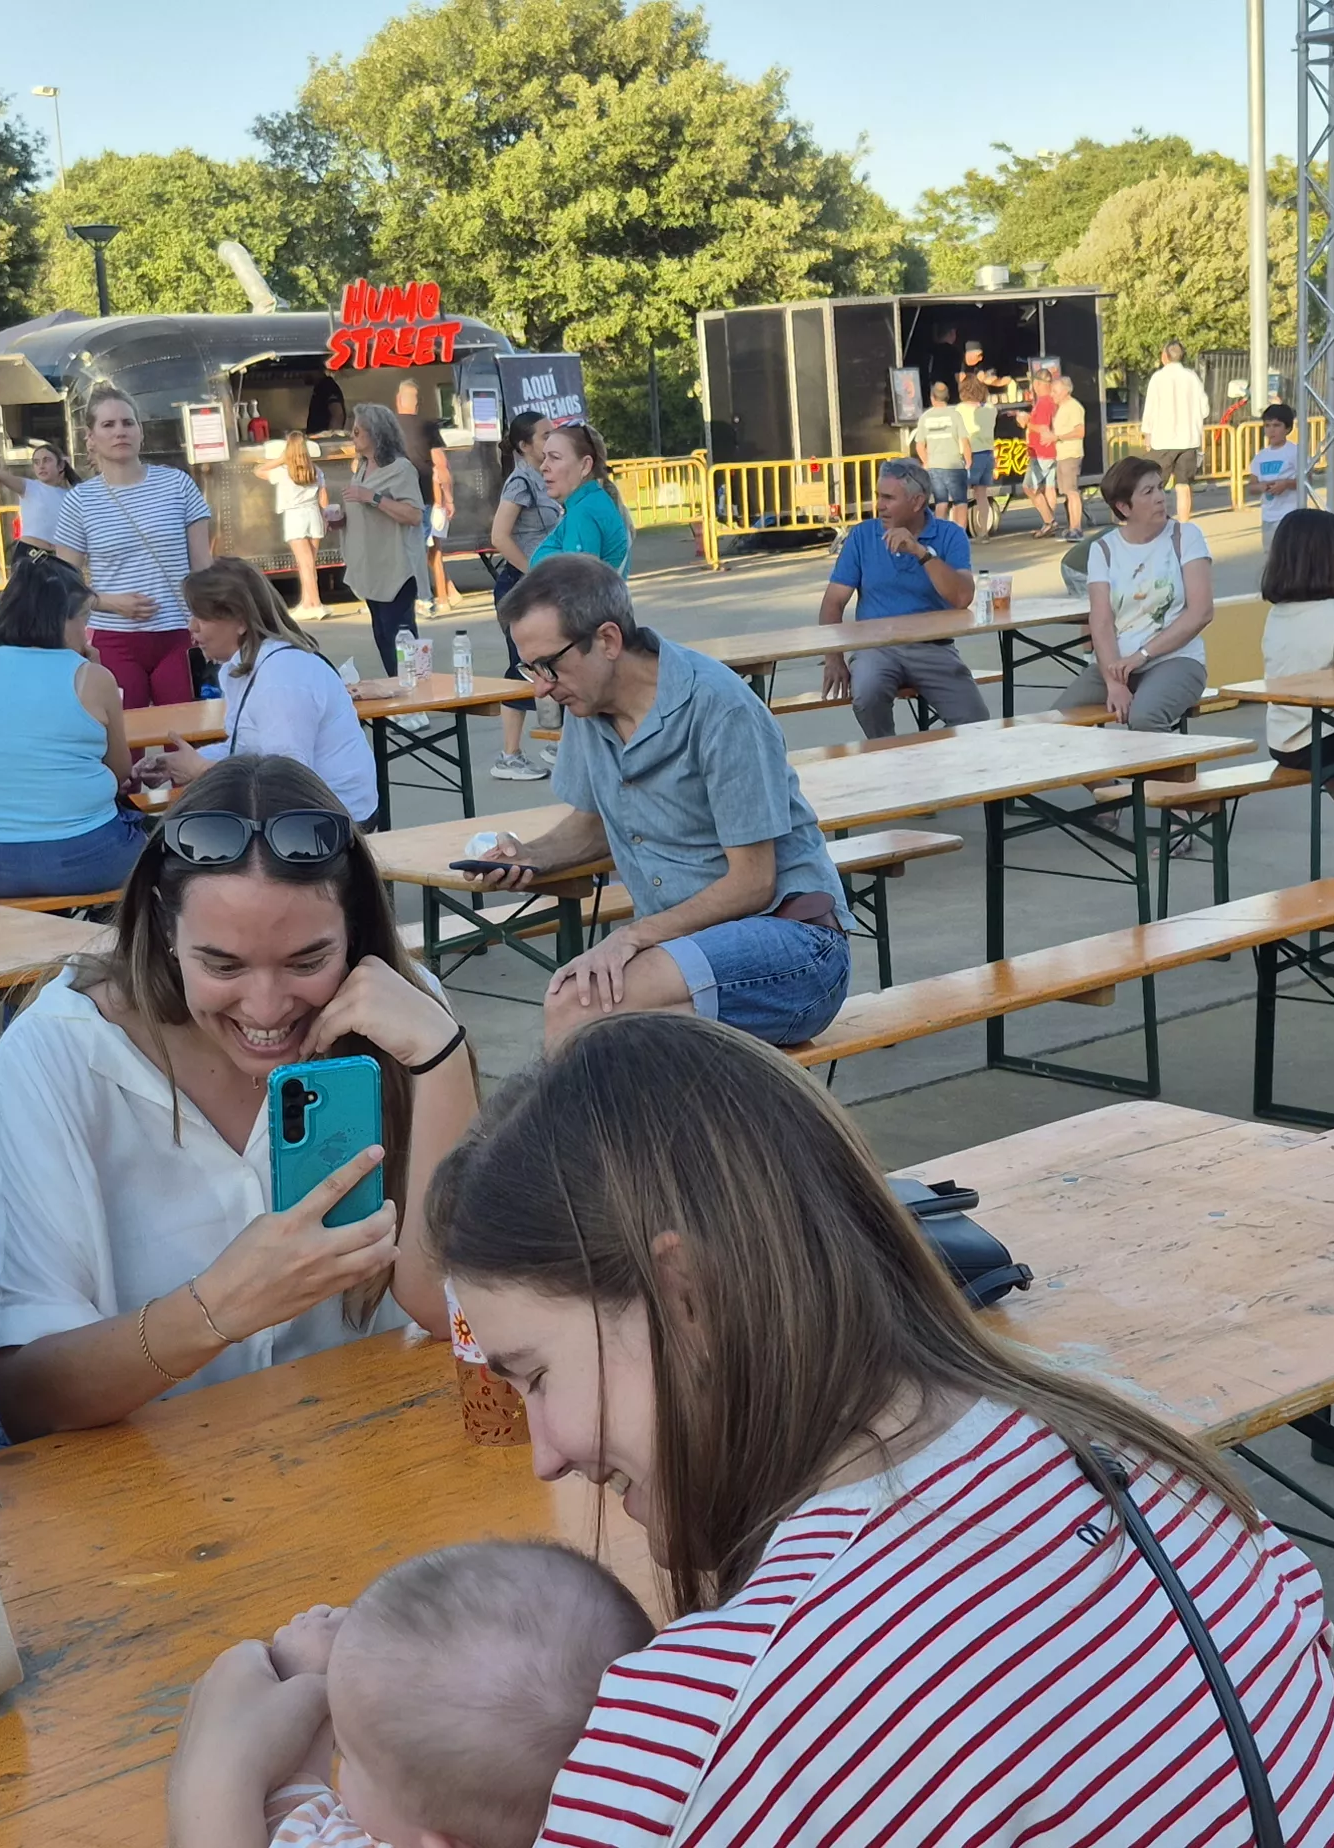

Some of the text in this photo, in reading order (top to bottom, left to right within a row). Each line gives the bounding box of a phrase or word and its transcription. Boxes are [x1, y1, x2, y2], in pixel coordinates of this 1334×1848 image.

[341, 278, 441, 326] HUMO
[325, 321, 463, 370] STREET
[522, 367, 557, 401] AQUÍ
